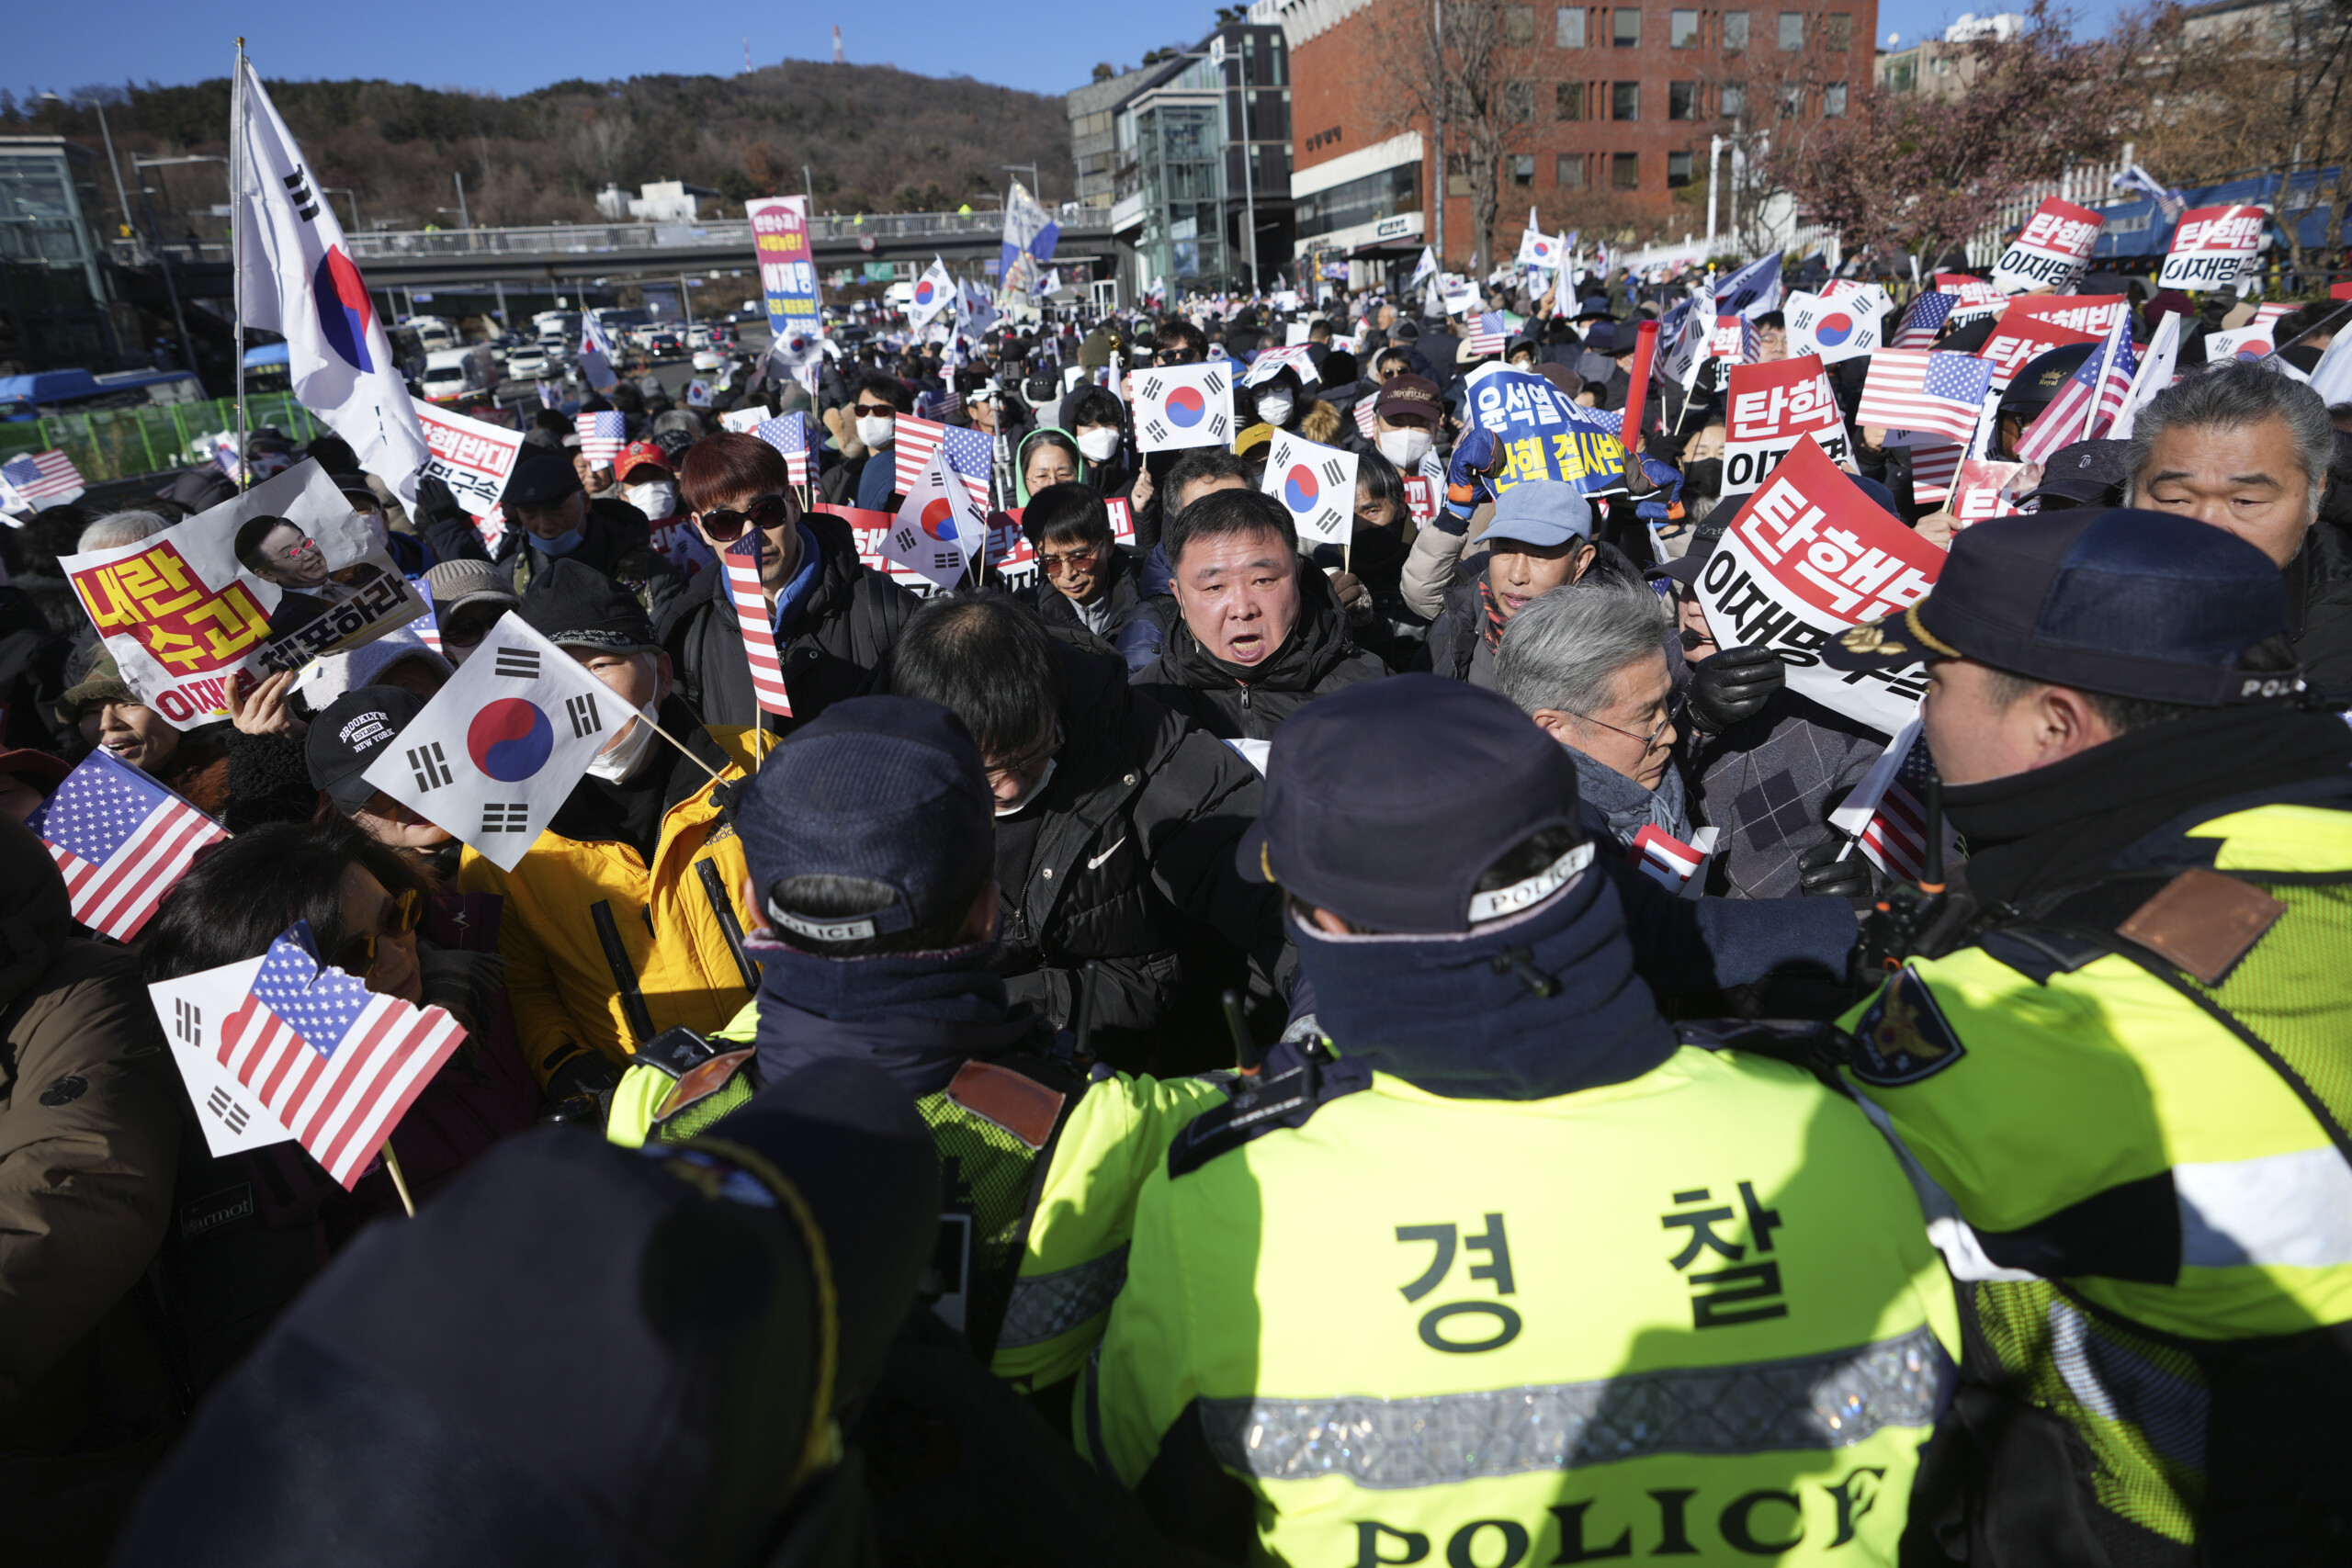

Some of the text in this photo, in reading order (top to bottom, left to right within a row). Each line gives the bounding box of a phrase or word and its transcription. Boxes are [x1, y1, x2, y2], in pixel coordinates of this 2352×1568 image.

[763, 262, 813, 294] 이재명
[1477, 382, 1562, 434] 윤석열
[2038, 378, 2059, 387] Royal
[451, 471, 499, 505] 구속
[1494, 435, 1550, 494] 탄핵
[74, 547, 203, 628] 내란
[147, 586, 274, 671] 수괴
[257, 572, 410, 673] 체포하라
[339, 711, 390, 744] BROOKLYN
[353, 728, 396, 753] NEW YORK
[704, 827, 734, 846] adida
[1491, 855, 1577, 911] POLICE
[772, 908, 864, 939] POLICE
[1395, 1181, 1789, 1354] 경 찰
[1346, 1467, 1887, 1568] POLICE
